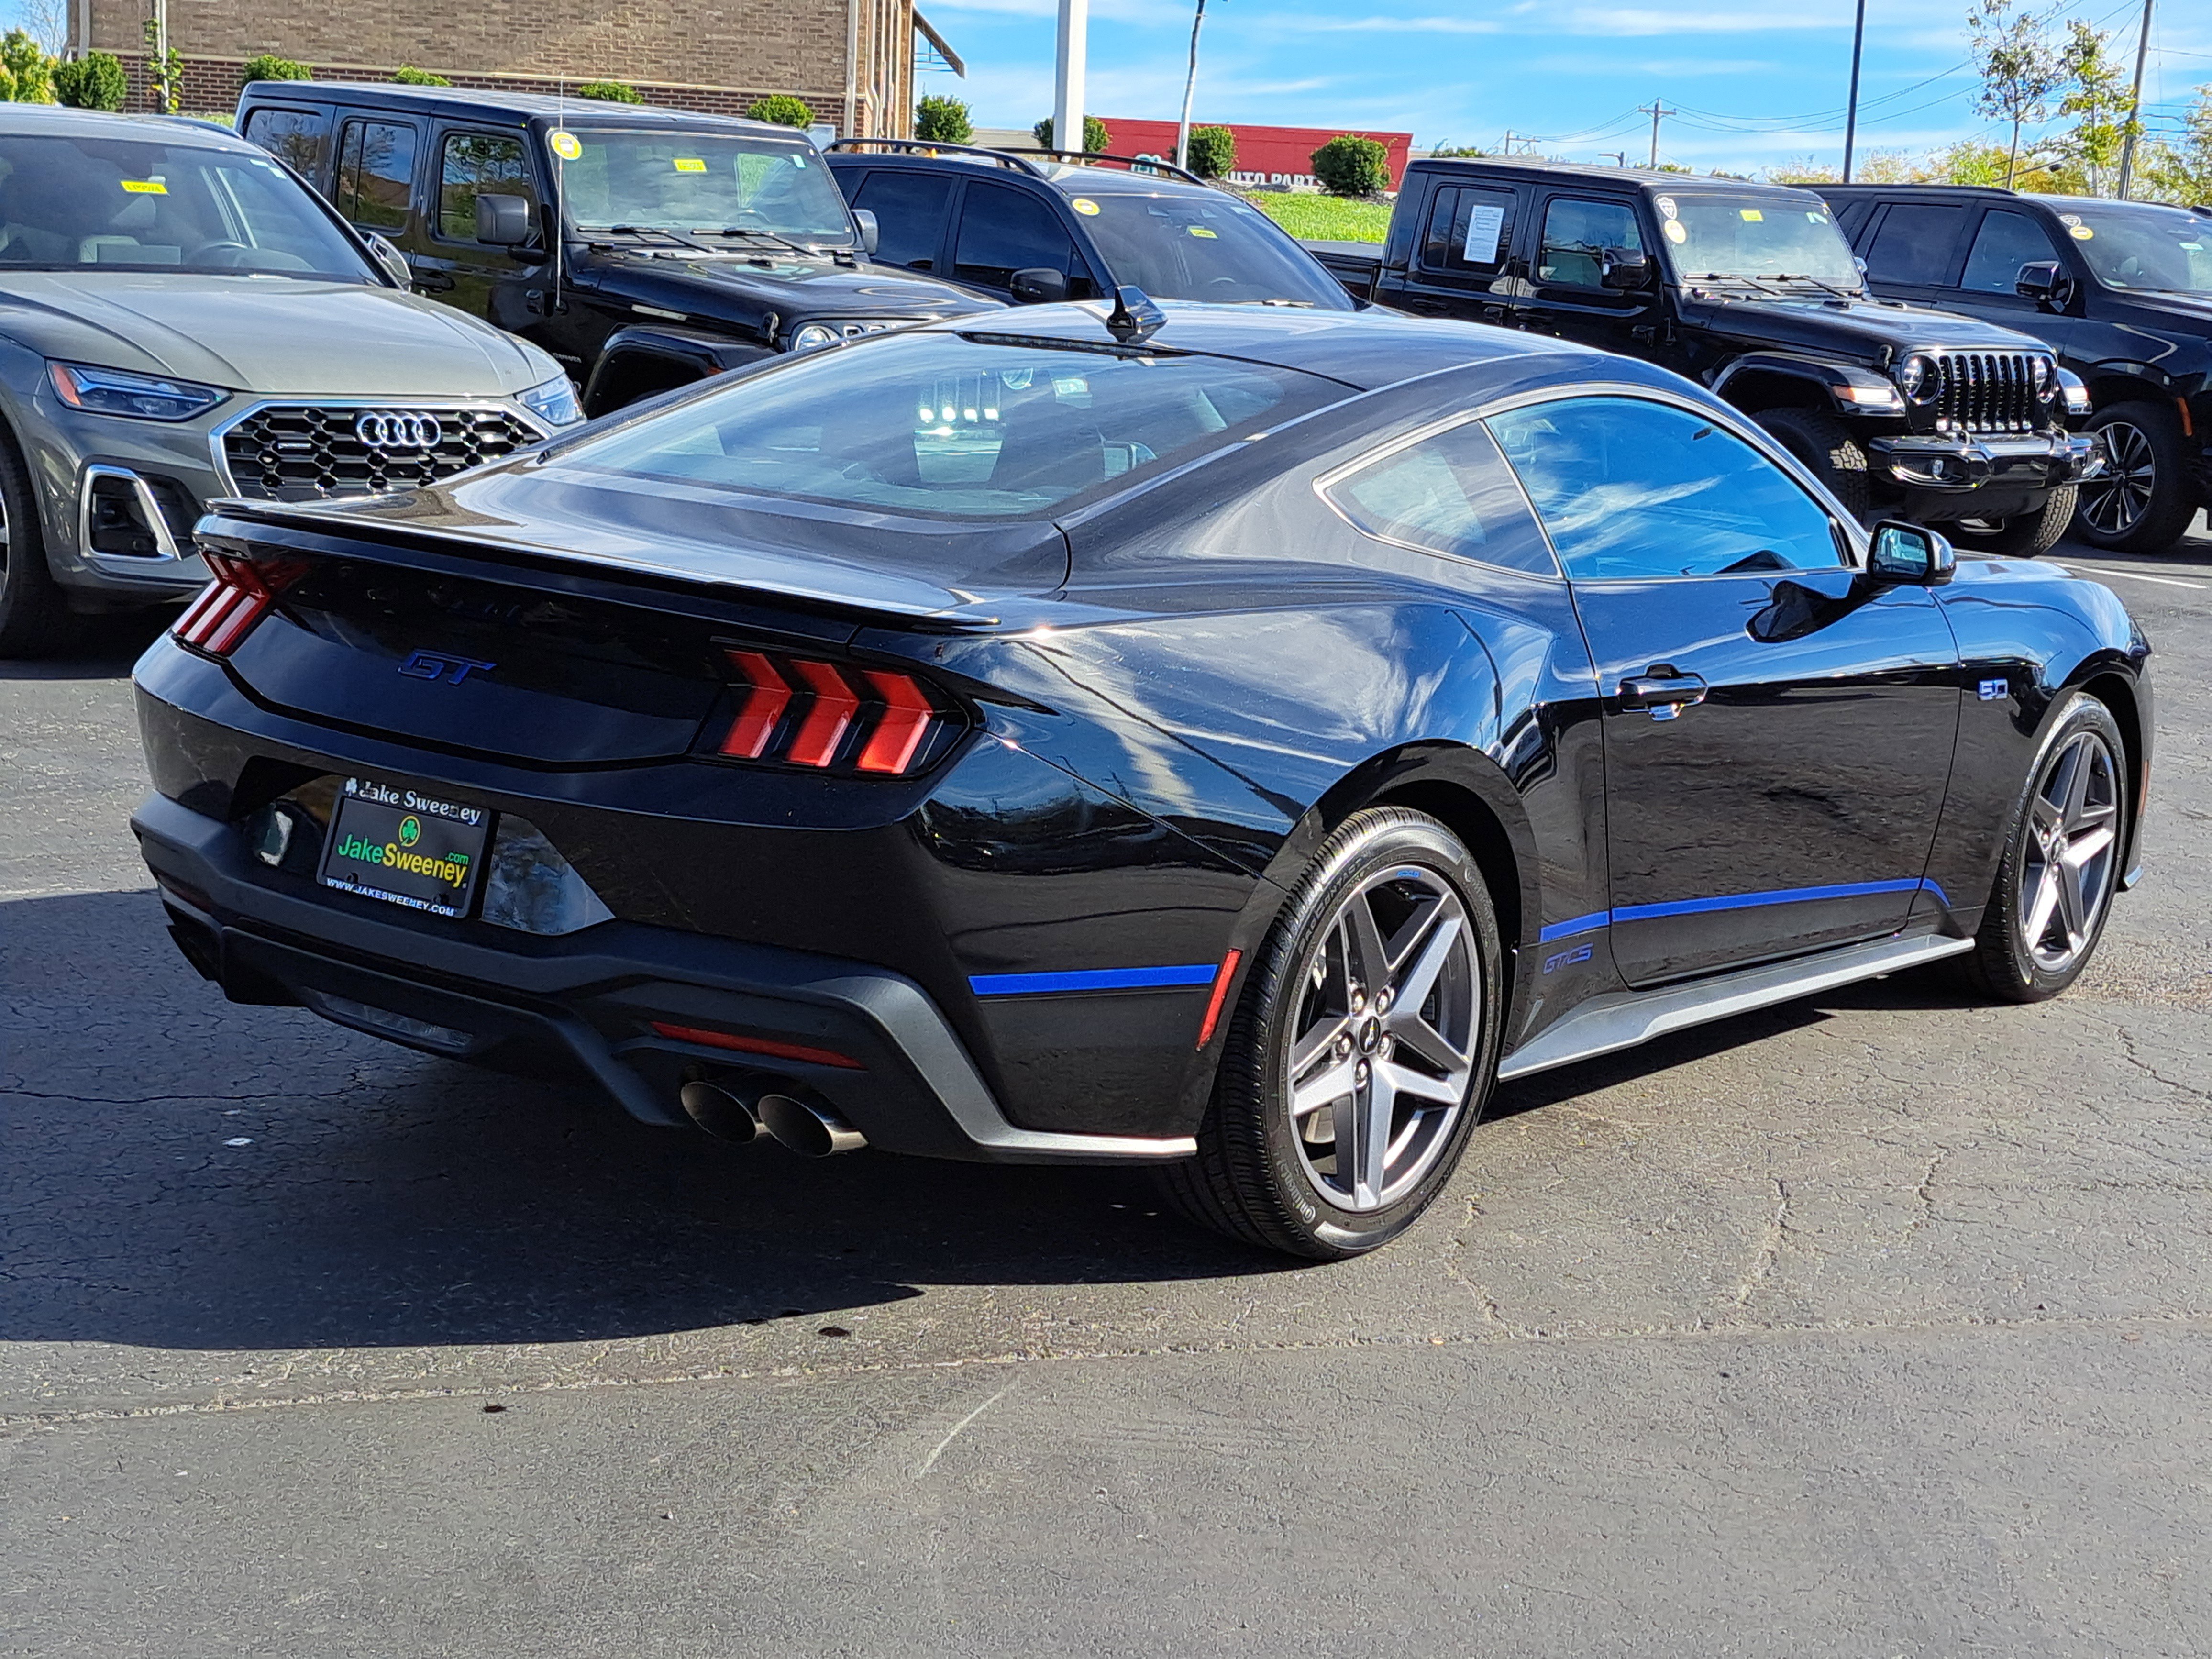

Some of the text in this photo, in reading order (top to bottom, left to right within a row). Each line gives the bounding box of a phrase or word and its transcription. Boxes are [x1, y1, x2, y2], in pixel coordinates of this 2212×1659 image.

[1271, 173, 1325, 187] PART
[398, 649, 497, 685] GT
[359, 781, 481, 825] Jake Sweeney
